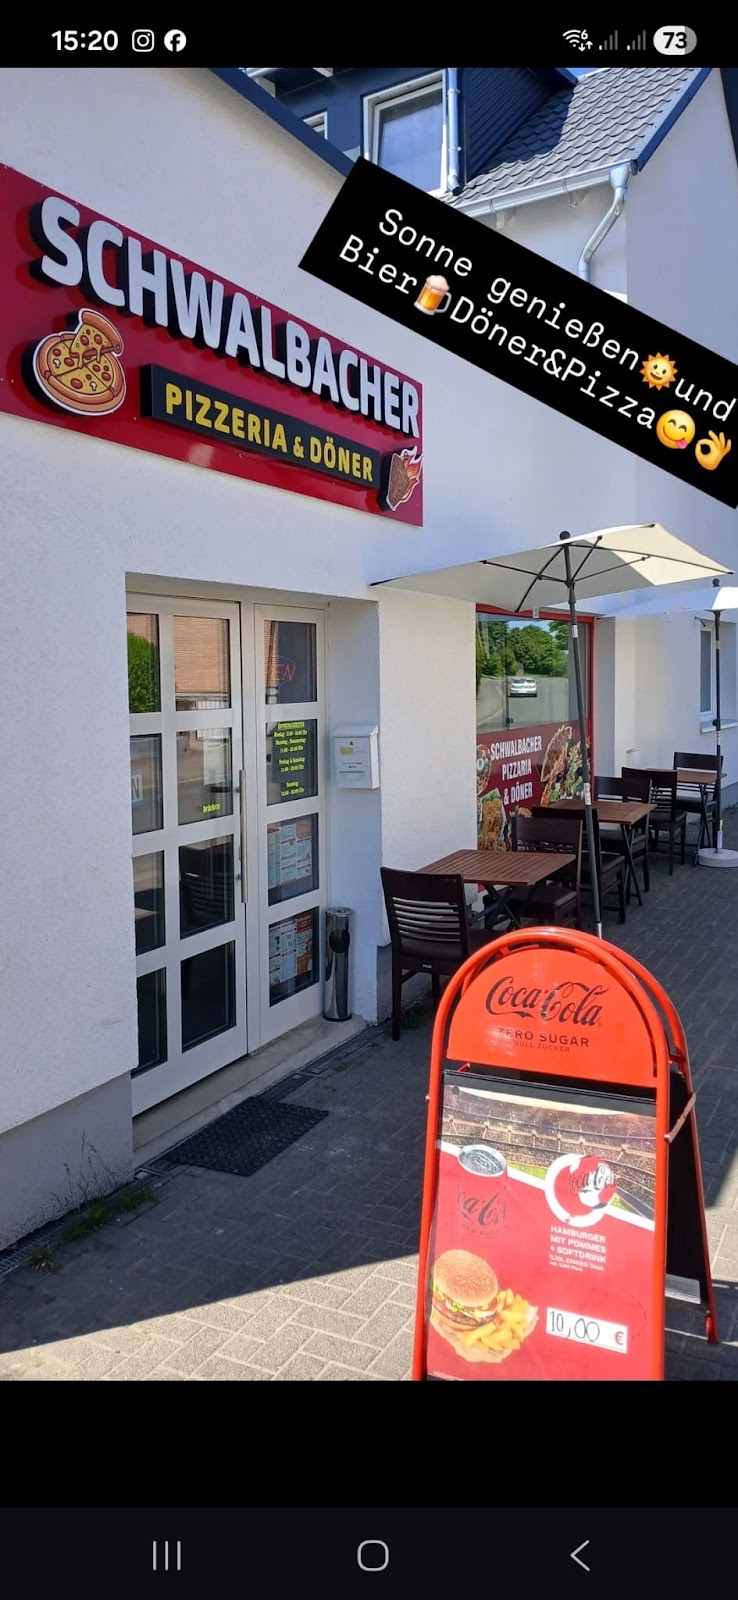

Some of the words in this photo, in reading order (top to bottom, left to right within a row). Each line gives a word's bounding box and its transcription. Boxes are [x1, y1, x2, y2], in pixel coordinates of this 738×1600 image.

[40, 196, 421, 439] SCHWALBACHER
[165, 383, 288, 454] PIZZERIA
[292, 435, 305, 459] &
[309, 437, 374, 482] DÖNER
[490, 736, 542, 761] SCHWALBACHER
[502, 759, 532, 781] PIZZARIA
[504, 788, 510, 805] &
[511, 781, 533, 803] DÖNER
[485, 976, 610, 1026] Coca-Cola
[497, 1027, 534, 1041] ZERO
[539, 1033, 589, 1048] SUGAR
[550, 1225, 606, 1243] HAMBURGER
[550, 1235, 566, 1245] MIT
[567, 1239, 607, 1253] POMMES
[557, 1246, 607, 1263] SOFTDRINK
[549, 1310, 601, 1343] 10,00
[614, 1331, 624, 1346] €
